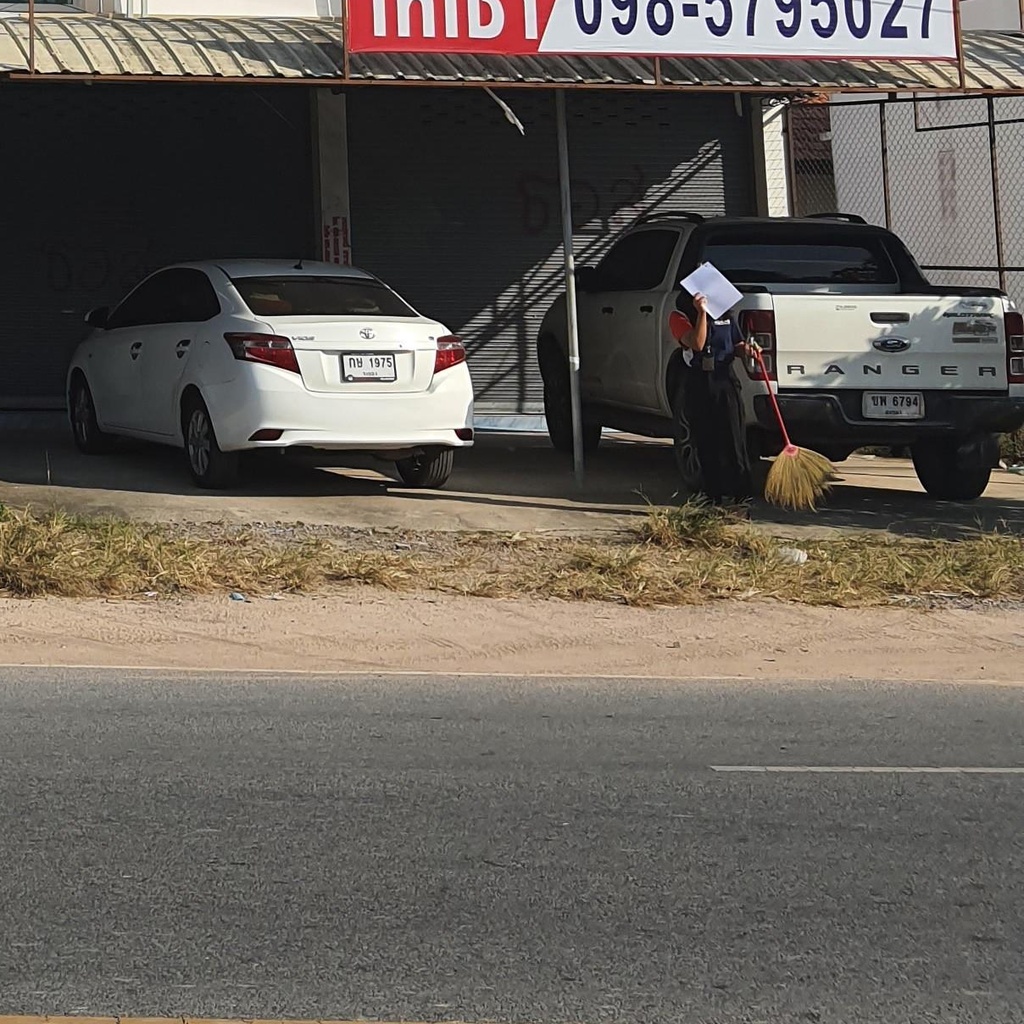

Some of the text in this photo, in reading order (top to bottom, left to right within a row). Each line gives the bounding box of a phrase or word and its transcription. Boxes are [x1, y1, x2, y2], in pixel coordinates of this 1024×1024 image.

[369, 357, 392, 368] 1975
[787, 364, 997, 377] RANGER
[893, 396, 918, 407] 6794
